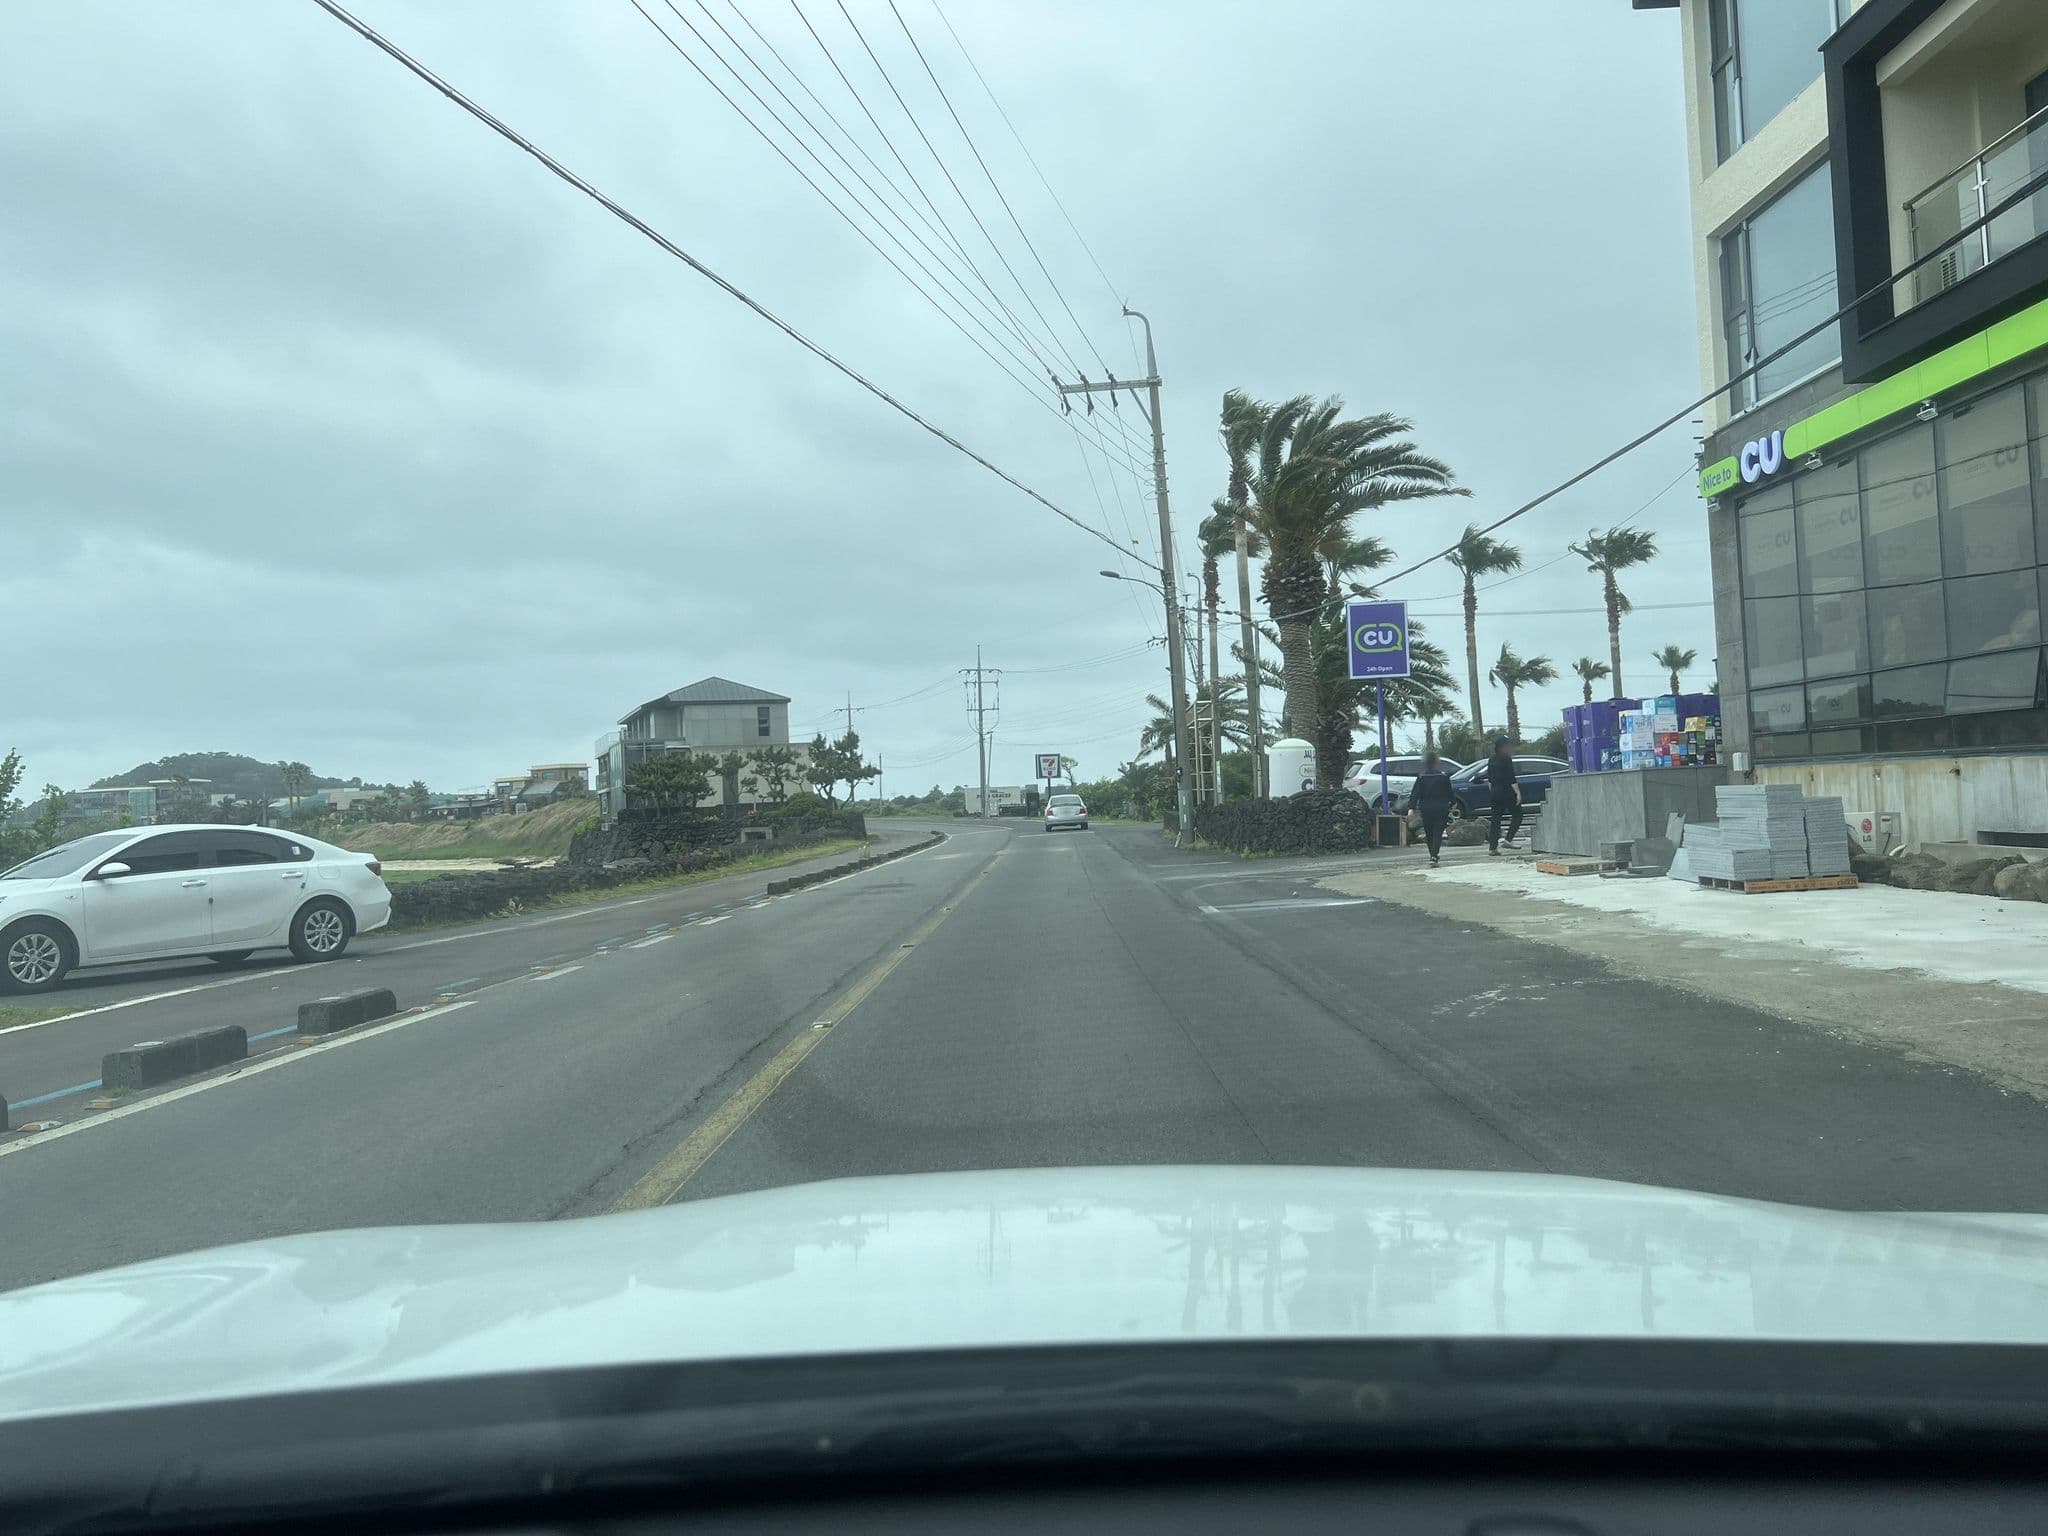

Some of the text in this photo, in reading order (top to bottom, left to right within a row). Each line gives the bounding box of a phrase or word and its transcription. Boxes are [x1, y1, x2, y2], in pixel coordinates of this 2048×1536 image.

[1703, 430, 1782, 491] Nice to CU
[1363, 630, 1393, 646] CU
